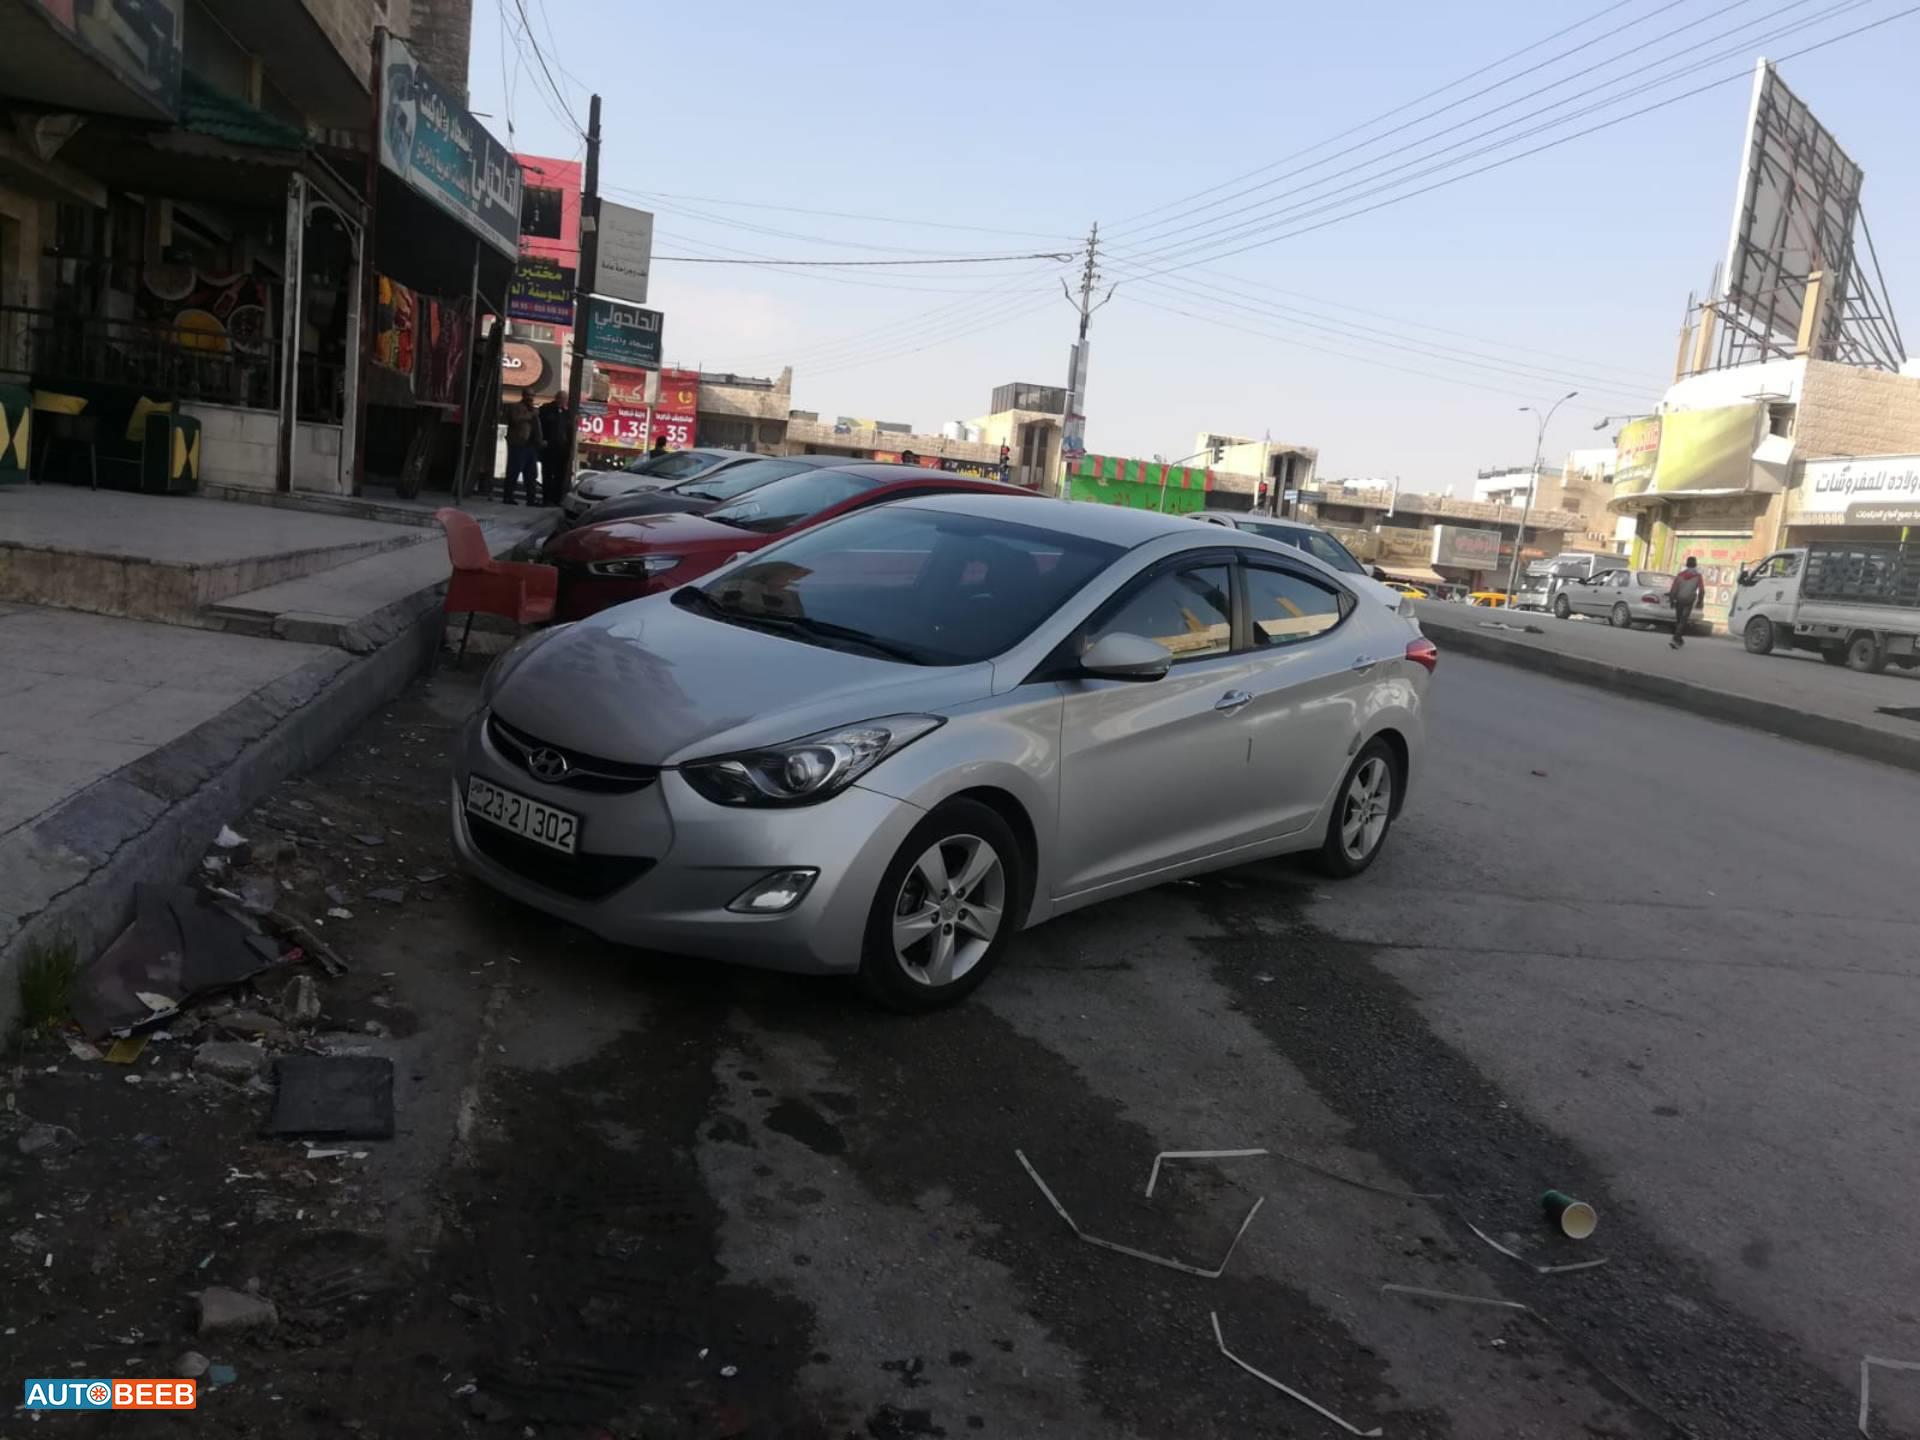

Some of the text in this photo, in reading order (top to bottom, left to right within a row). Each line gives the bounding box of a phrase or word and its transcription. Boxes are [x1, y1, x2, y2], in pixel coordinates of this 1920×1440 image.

[594, 304, 660, 333] الحلحولي
[1815, 464, 1920, 496] ولاده للمفروشات
